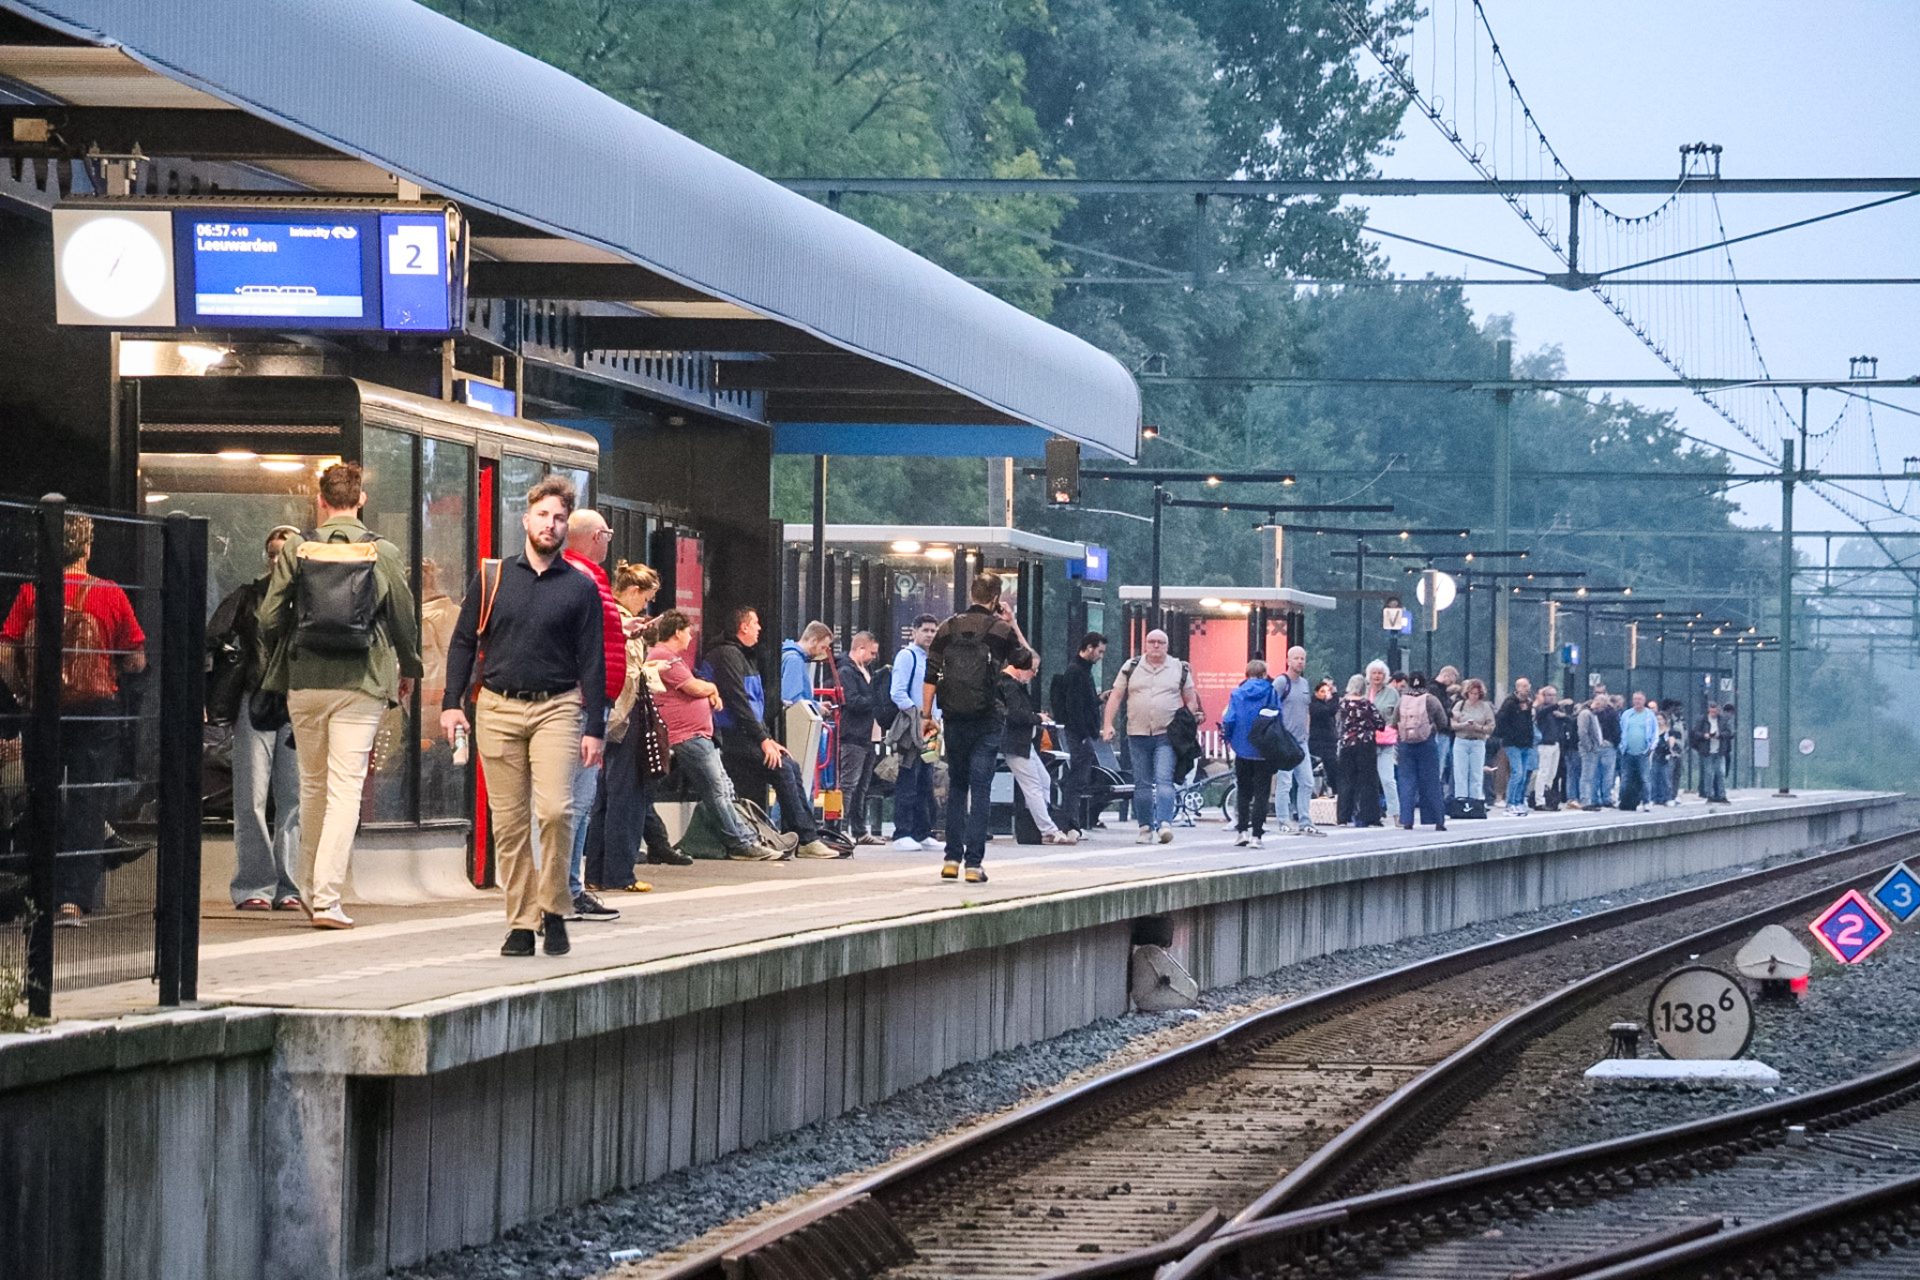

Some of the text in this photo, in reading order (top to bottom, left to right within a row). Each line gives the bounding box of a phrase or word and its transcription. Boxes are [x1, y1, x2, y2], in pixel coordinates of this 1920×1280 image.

[196, 224, 230, 237] 06:57
[289, 226, 331, 239] Intercity
[197, 238, 277, 252] Leeuwarden
[406, 244, 422, 269] 2
[1892, 883, 1912, 907] 3
[1836, 913, 1865, 946] 2
[1660, 1001, 1716, 1034] 138
